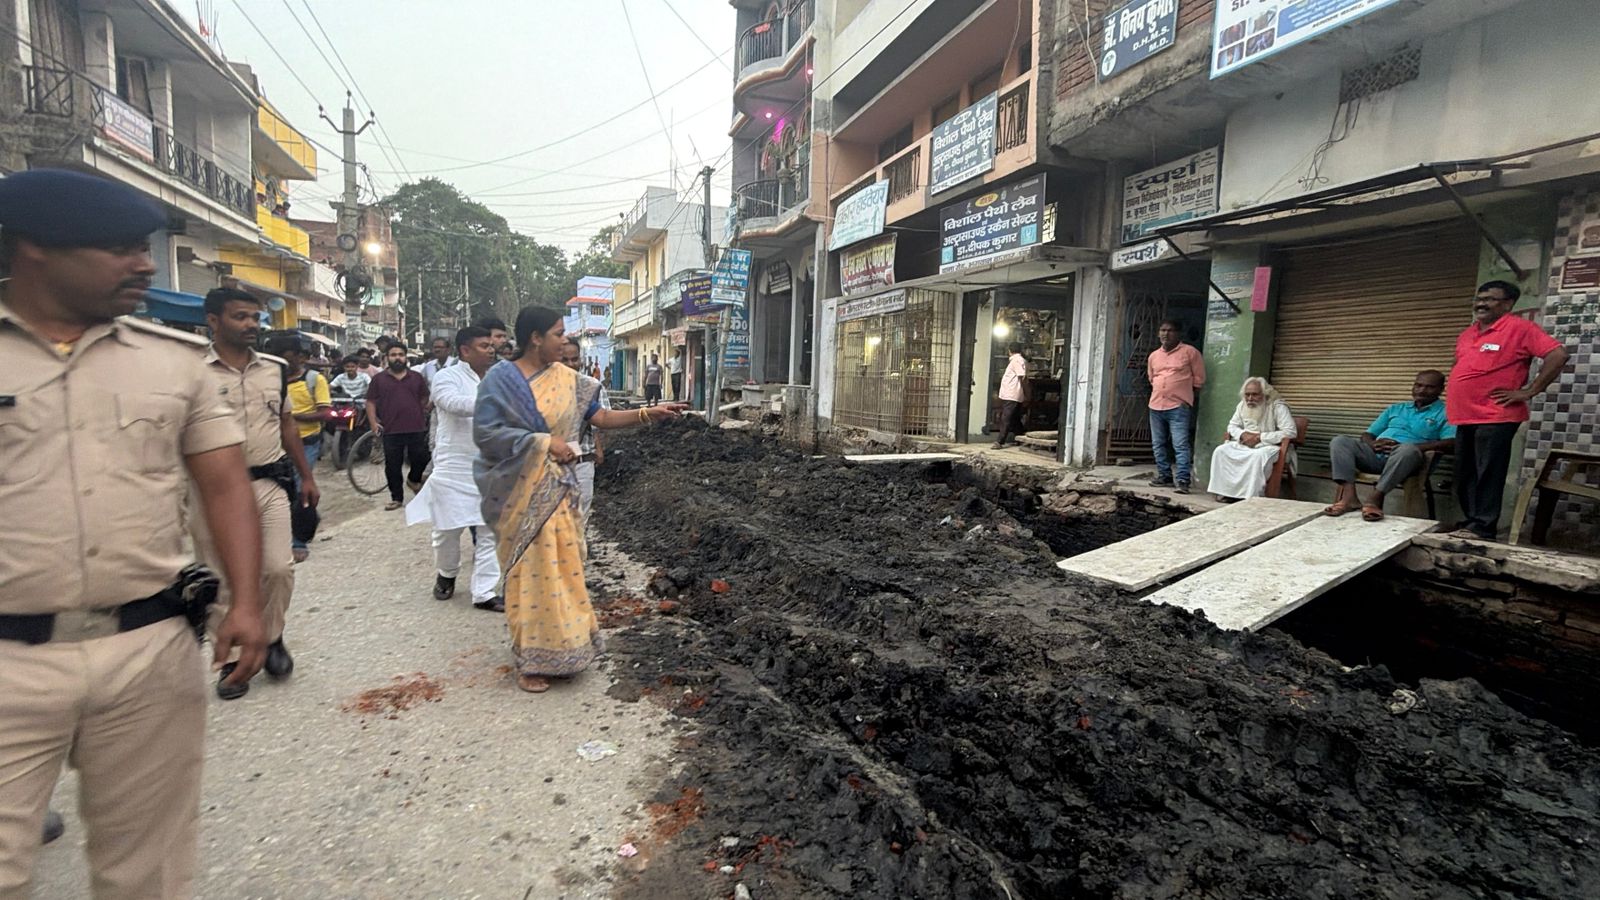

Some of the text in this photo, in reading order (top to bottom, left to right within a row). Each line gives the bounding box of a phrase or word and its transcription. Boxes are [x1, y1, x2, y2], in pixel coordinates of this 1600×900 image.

[1119, 5, 1147, 42] विनय
[1132, 26, 1171, 51] D.H.M.S.
[1148, 37, 1170, 52] M.D.
[934, 129, 960, 152] विशाल
[944, 211, 983, 232] विशाल
[984, 201, 1009, 218] पैथो
[1010, 211, 1038, 227] सेन्टर
[992, 231, 1018, 251] कुमार
